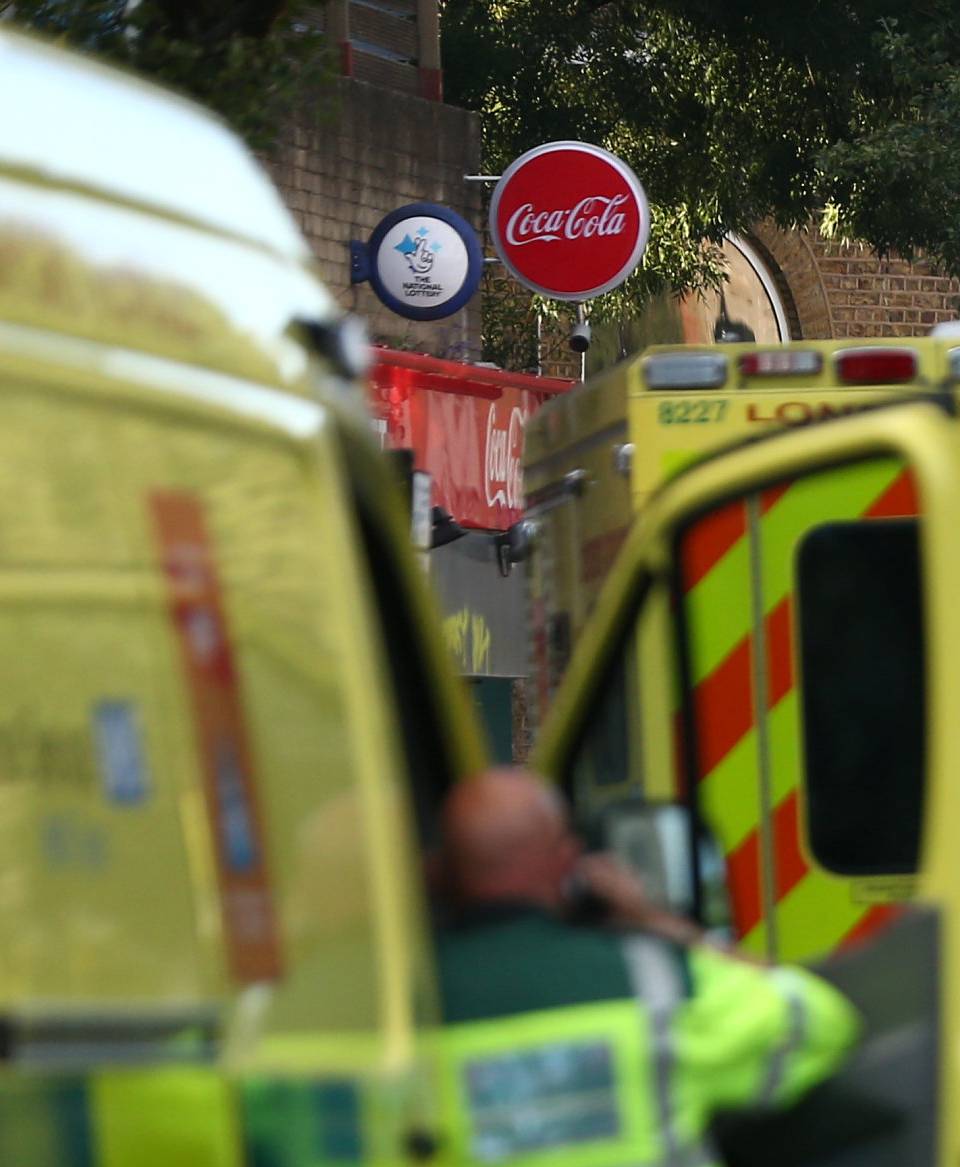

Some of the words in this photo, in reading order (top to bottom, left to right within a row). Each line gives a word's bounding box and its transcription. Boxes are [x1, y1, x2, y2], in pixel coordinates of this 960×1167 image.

[506, 193, 629, 245] Coca-Cola
[402, 282, 443, 291] NATIONAL
[414, 275, 431, 283] THE
[657, 399, 729, 424] 8227
